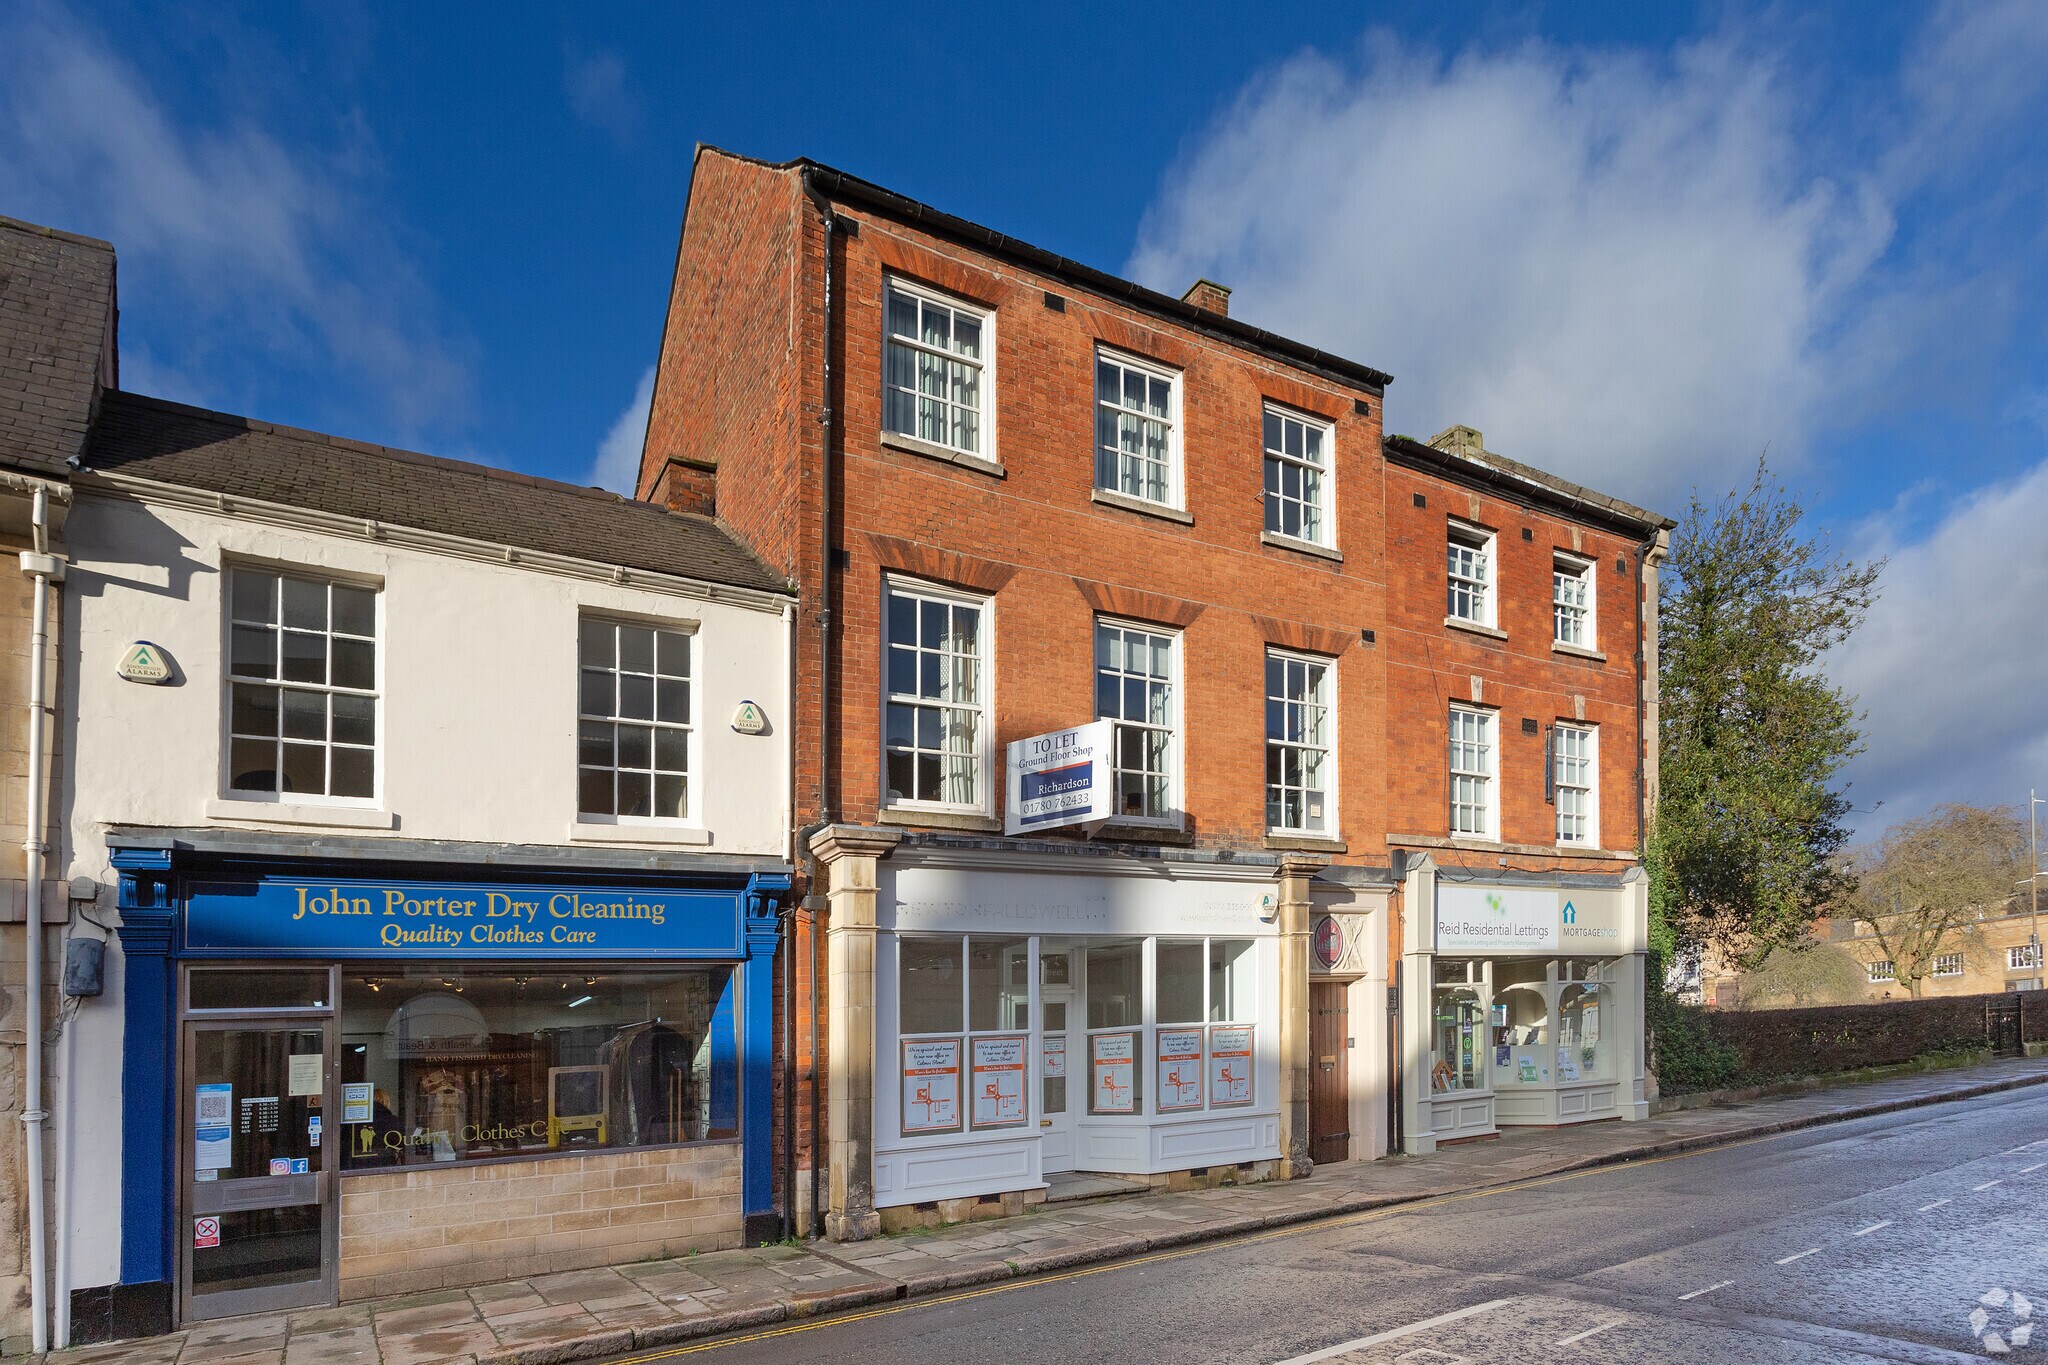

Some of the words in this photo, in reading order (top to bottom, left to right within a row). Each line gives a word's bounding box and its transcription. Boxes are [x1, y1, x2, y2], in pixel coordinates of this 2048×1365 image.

[126, 668, 161, 676] ALARMS
[1033, 738, 1051, 754] TO
[1055, 732, 1078, 749] LET
[1019, 754, 1048, 769] Ground
[1050, 751, 1070, 762] Floor
[1073, 746, 1093, 757] Shop
[1038, 778, 1089, 795] Richardson
[1024, 800, 1051, 814] 01780
[1055, 793, 1088, 808] 762433
[293, 888, 372, 920] John
[382, 890, 476, 917] Porter
[485, 893, 540, 923] Dry
[549, 894, 665, 925] Cleaning
[381, 924, 463, 947] Quality
[470, 925, 544, 943] Clothes
[551, 926, 596, 943] Care
[1439, 922, 1460, 935] Reid
[1463, 922, 1512, 936] Residential
[1515, 924, 1549, 939] Lettings
[1563, 926, 1618, 938] MORTGAGEshop
[451, 1054, 487, 1062] FINISHED
[384, 1127, 453, 1150] Quality
[461, 1123, 525, 1142] Clothes
